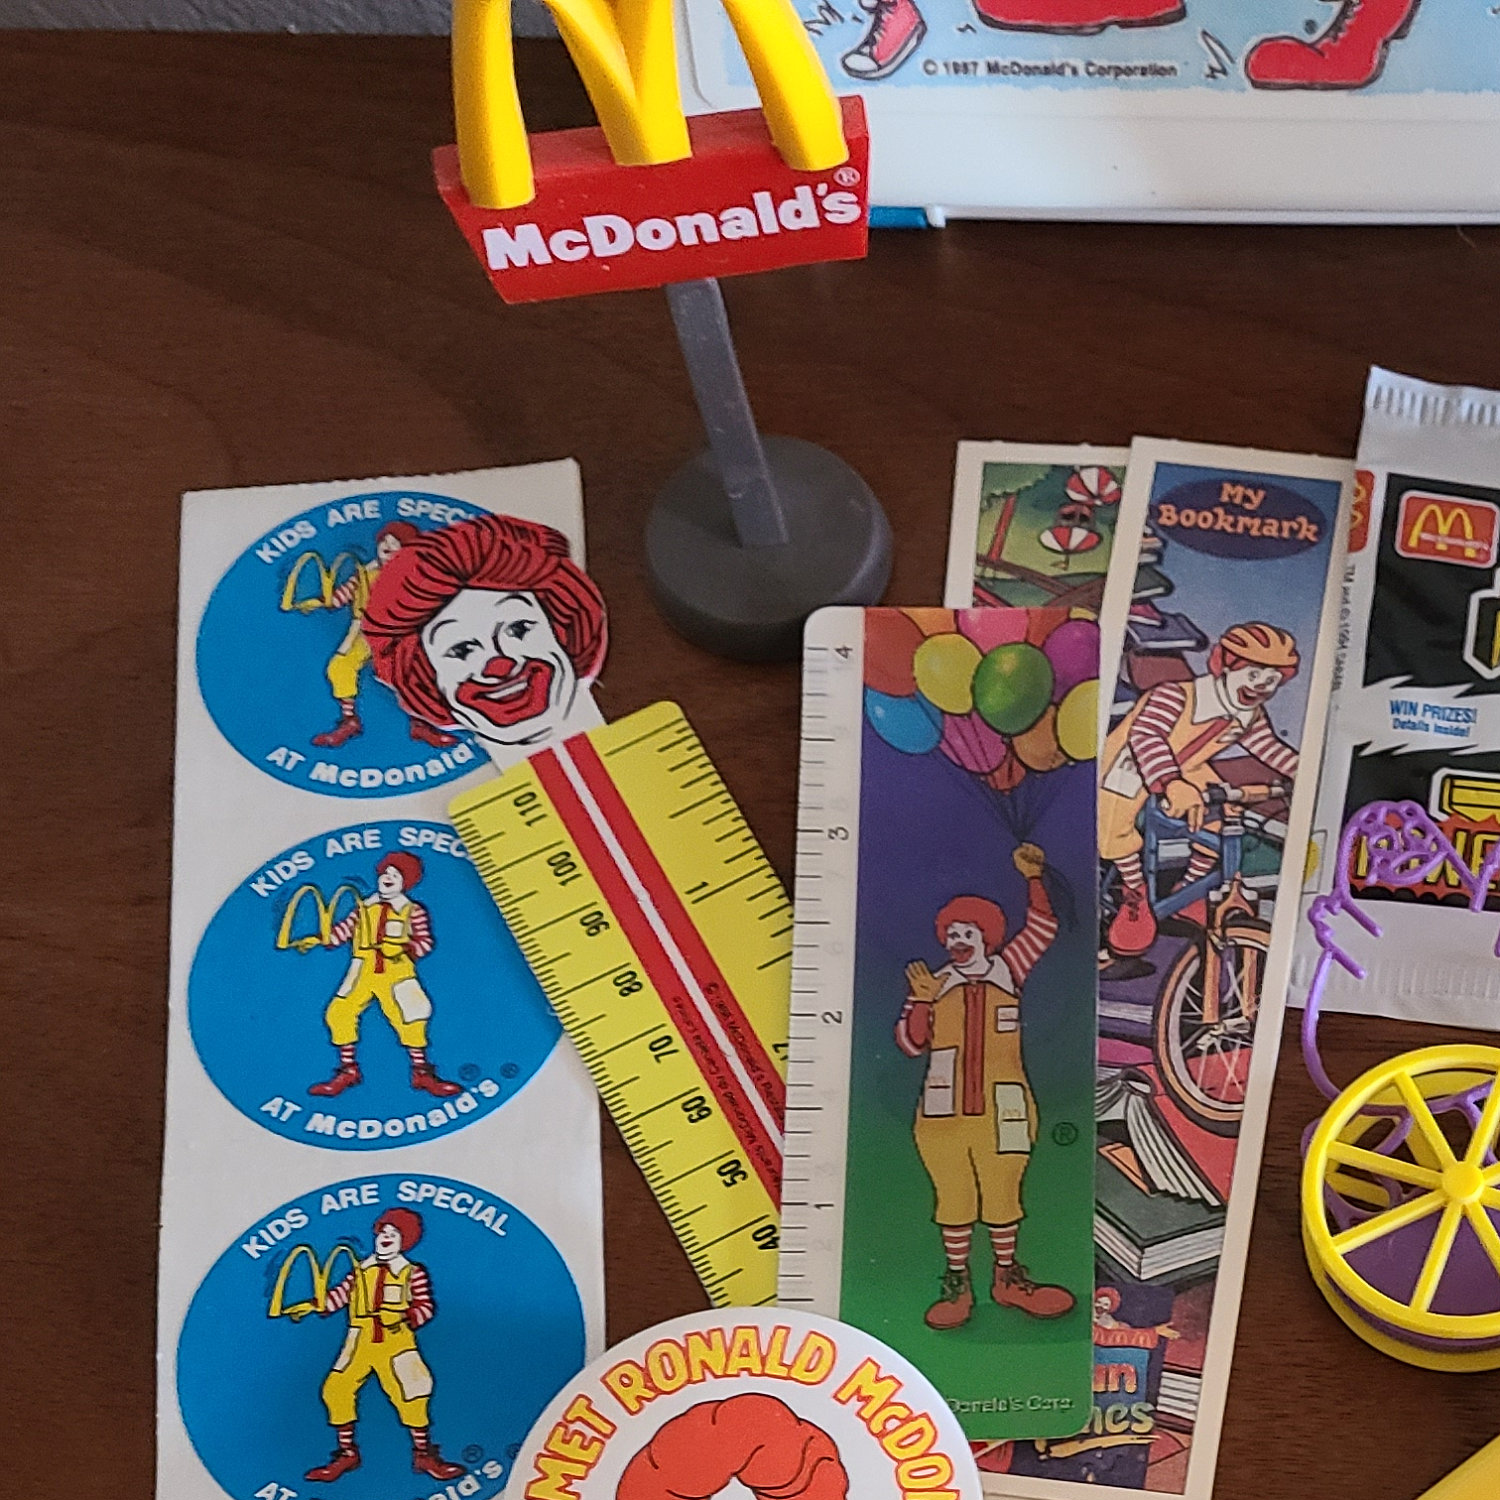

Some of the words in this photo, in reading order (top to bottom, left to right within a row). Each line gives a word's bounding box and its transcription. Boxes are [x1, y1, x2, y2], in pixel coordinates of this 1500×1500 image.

[986, 60, 1080, 78] McDonald's
[1085, 61, 1178, 79] Corporation
[1219, 480, 1267, 513] My
[255, 519, 317, 565] KIDS
[326, 500, 381, 527] ARE
[397, 497, 476, 527] SPEC
[1156, 503, 1320, 544] Bookmark
[834, 644, 855, 662] 4
[1390, 700, 1419, 718] WIN
[1422, 702, 1478, 725] PRIZES!
[1392, 718, 1435, 734] Details
[266, 744, 305, 768] AT
[309, 735, 478, 789] McDonald'
[513, 790, 548, 828] 110
[826, 824, 850, 842] 3
[248, 850, 316, 899] KIDS
[325, 827, 382, 858] ARE
[398, 826, 474, 860] SPEC
[546, 850, 583, 888] 100
[580, 909, 610, 938] 90
[612, 969, 643, 998] 80
[821, 1009, 844, 1025] 2
[648, 1033, 680, 1064] 70
[260, 1095, 302, 1122] AT
[306, 1078, 500, 1140] McDonald's
[681, 1094, 713, 1125] 60
[717, 1158, 749, 1189] 50
[240, 1207, 310, 1261] KIDS
[320, 1183, 381, 1216] ARE
[397, 1181, 509, 1237] SPECIAL
[752, 1223, 781, 1252] 40
[600, 1325, 840, 1418] RONALD
